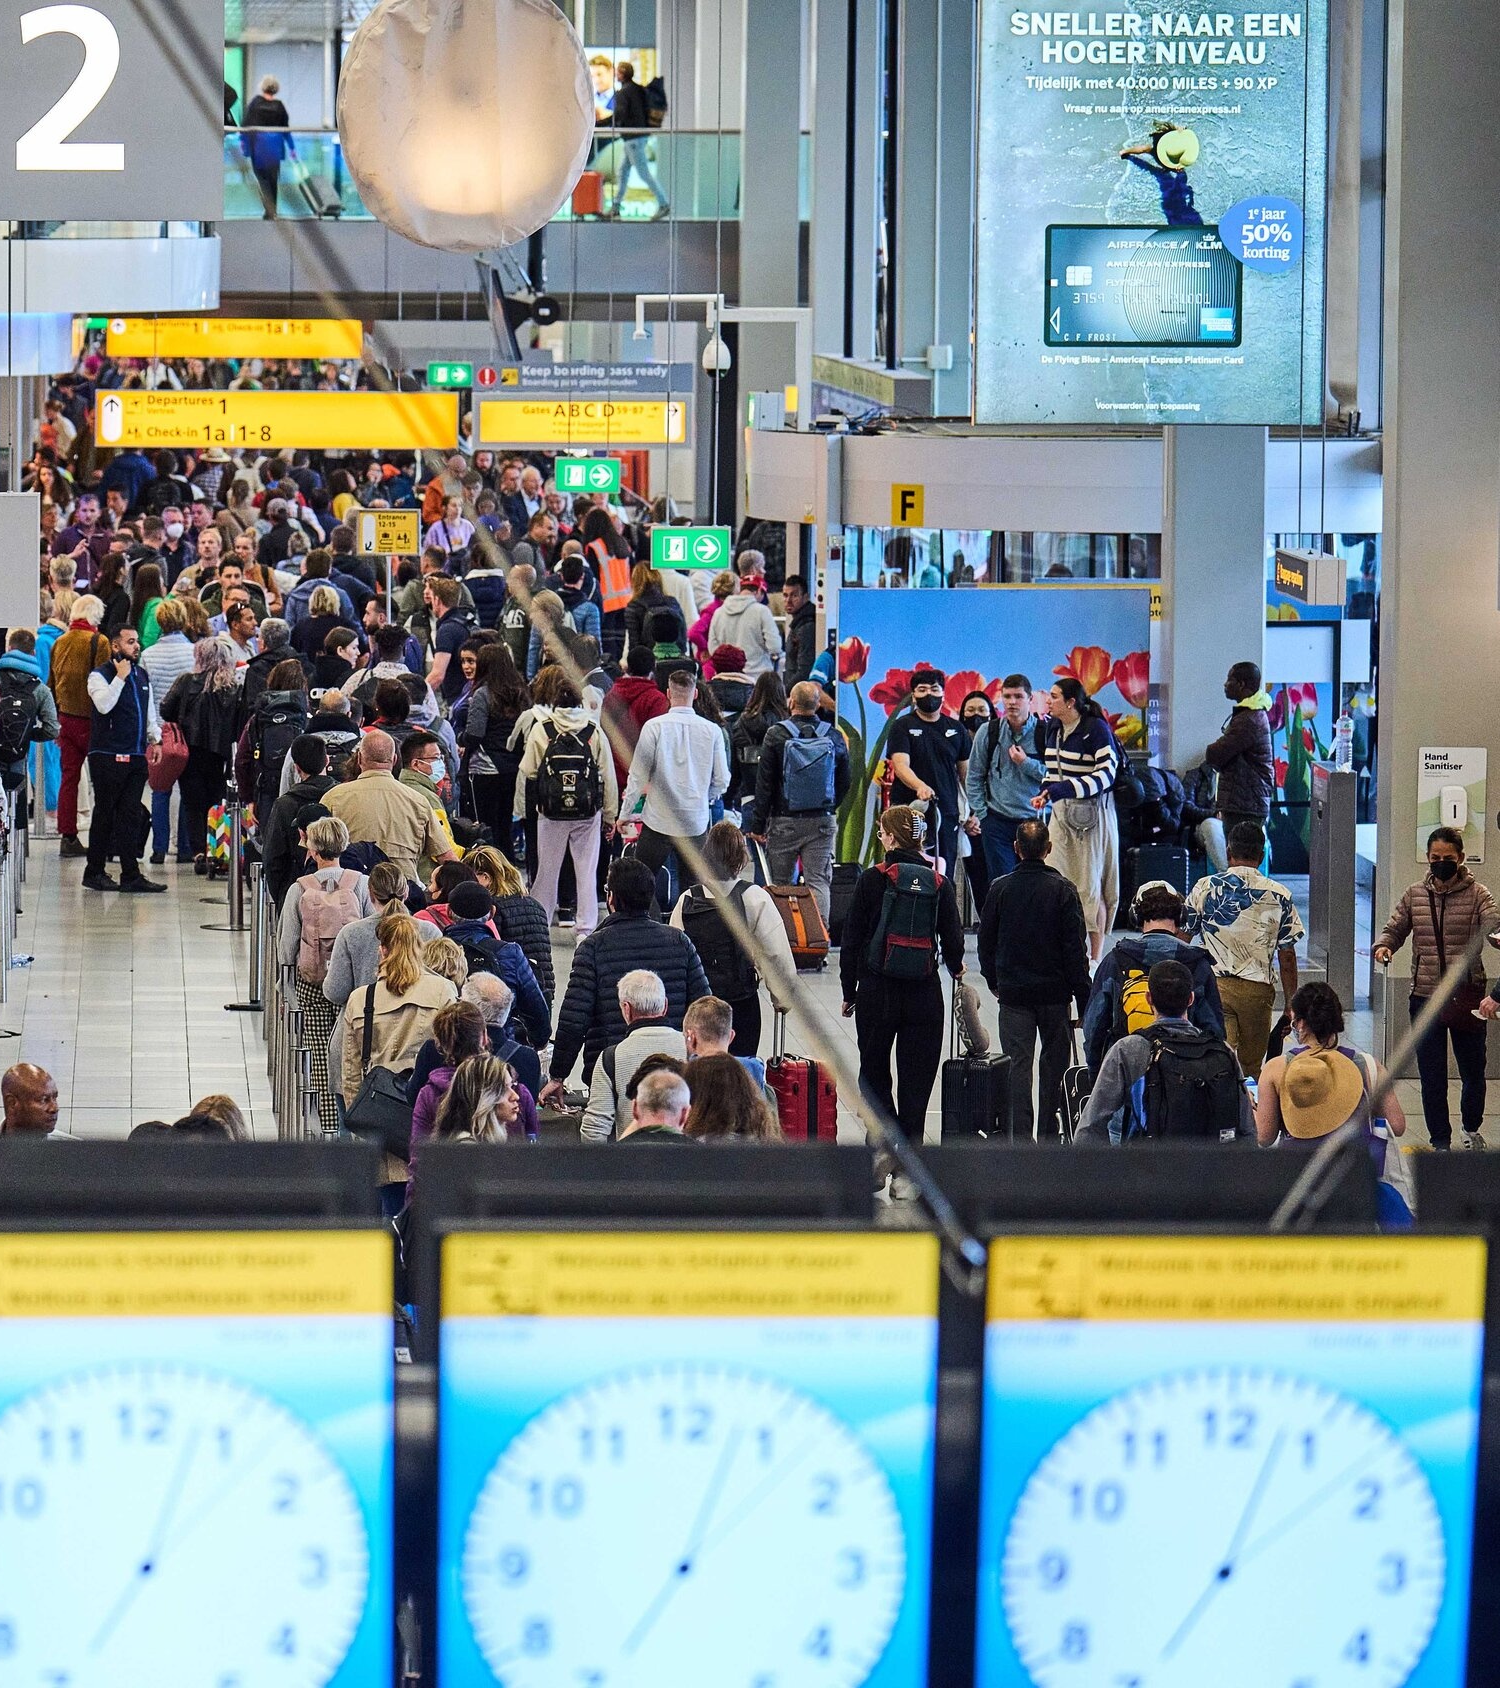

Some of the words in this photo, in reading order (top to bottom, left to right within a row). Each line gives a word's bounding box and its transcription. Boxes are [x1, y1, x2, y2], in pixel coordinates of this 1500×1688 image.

[1010, 12, 1143, 37] SNELLER
[1152, 13, 1234, 37] NAAR
[1244, 13, 1301, 37] EEN
[1042, 40, 1146, 65] HOGER
[1155, 41, 1266, 65] NIVEAU
[16, 4, 125, 172] 2
[1025, 75, 1082, 92] Tijdelijk
[1085, 78, 1113, 90] met
[1115, 77, 1169, 90] 40.000
[1172, 77, 1217, 90] MILES
[1233, 77, 1254, 90] 90
[1256, 77, 1278, 90] XP
[1063, 103, 1093, 116] Vraag
[1094, 105, 1108, 114] nu
[1110, 105, 1128, 114] aan
[1130, 105, 1144, 116] op
[1145, 103, 1241, 116] americanexpress.nl
[1260, 207, 1286, 221] jaar
[1107, 241, 1178, 249] AIRFRANCE
[1196, 241, 1223, 250] KLM
[1241, 223, 1292, 244] 50%
[1243, 246, 1290, 261] korting
[522, 365, 551, 380] Keep
[636, 365, 669, 381] ready
[1041, 356, 1053, 364] De
[1055, 355, 1080, 366] Flying
[1081, 355, 1100, 364] Blue
[1110, 355, 1149, 364] American
[1151, 355, 1183, 366] Express
[1184, 355, 1222, 364] Platinum
[1223, 355, 1244, 364] Card
[146, 395, 214, 407] Departures
[219, 399, 227, 415] 1
[522, 406, 551, 416] Gates
[554, 403, 567, 418] A
[570, 404, 580, 418] B
[584, 403, 595, 418] C
[603, 404, 615, 418] D
[1096, 401, 1145, 411] Voorwaarden
[1146, 403, 1159, 411] van
[1161, 402, 1200, 412] toepassing
[146, 427, 198, 438] Check-in
[203, 425, 226, 442] 1a
[901, 490, 915, 522] F
[1424, 753, 1449, 761] Hand
[1424, 762, 1463, 771] Sanitiser
[118, 1402, 171, 1444] 12
[660, 1402, 713, 1445] 12
[1202, 1407, 1258, 1448] 12
[39, 1427, 84, 1462] 11
[217, 1427, 233, 1462] 1
[580, 1426, 624, 1463] 11
[757, 1426, 774, 1463] 1
[1121, 1429, 1167, 1467] 11
[1300, 1429, 1317, 1467] 1
[271, 1473, 300, 1514] 2
[528, 1476, 585, 1520] 10
[811, 1473, 841, 1516] 2
[1069, 1481, 1126, 1522] 10
[1353, 1479, 1382, 1520] 2
[499, 1545, 530, 1588] 9
[1039, 1550, 1069, 1592] 9
[269, 1623, 298, 1659] 4
[805, 1623, 832, 1659] 4
[1343, 1628, 1371, 1664] 4
